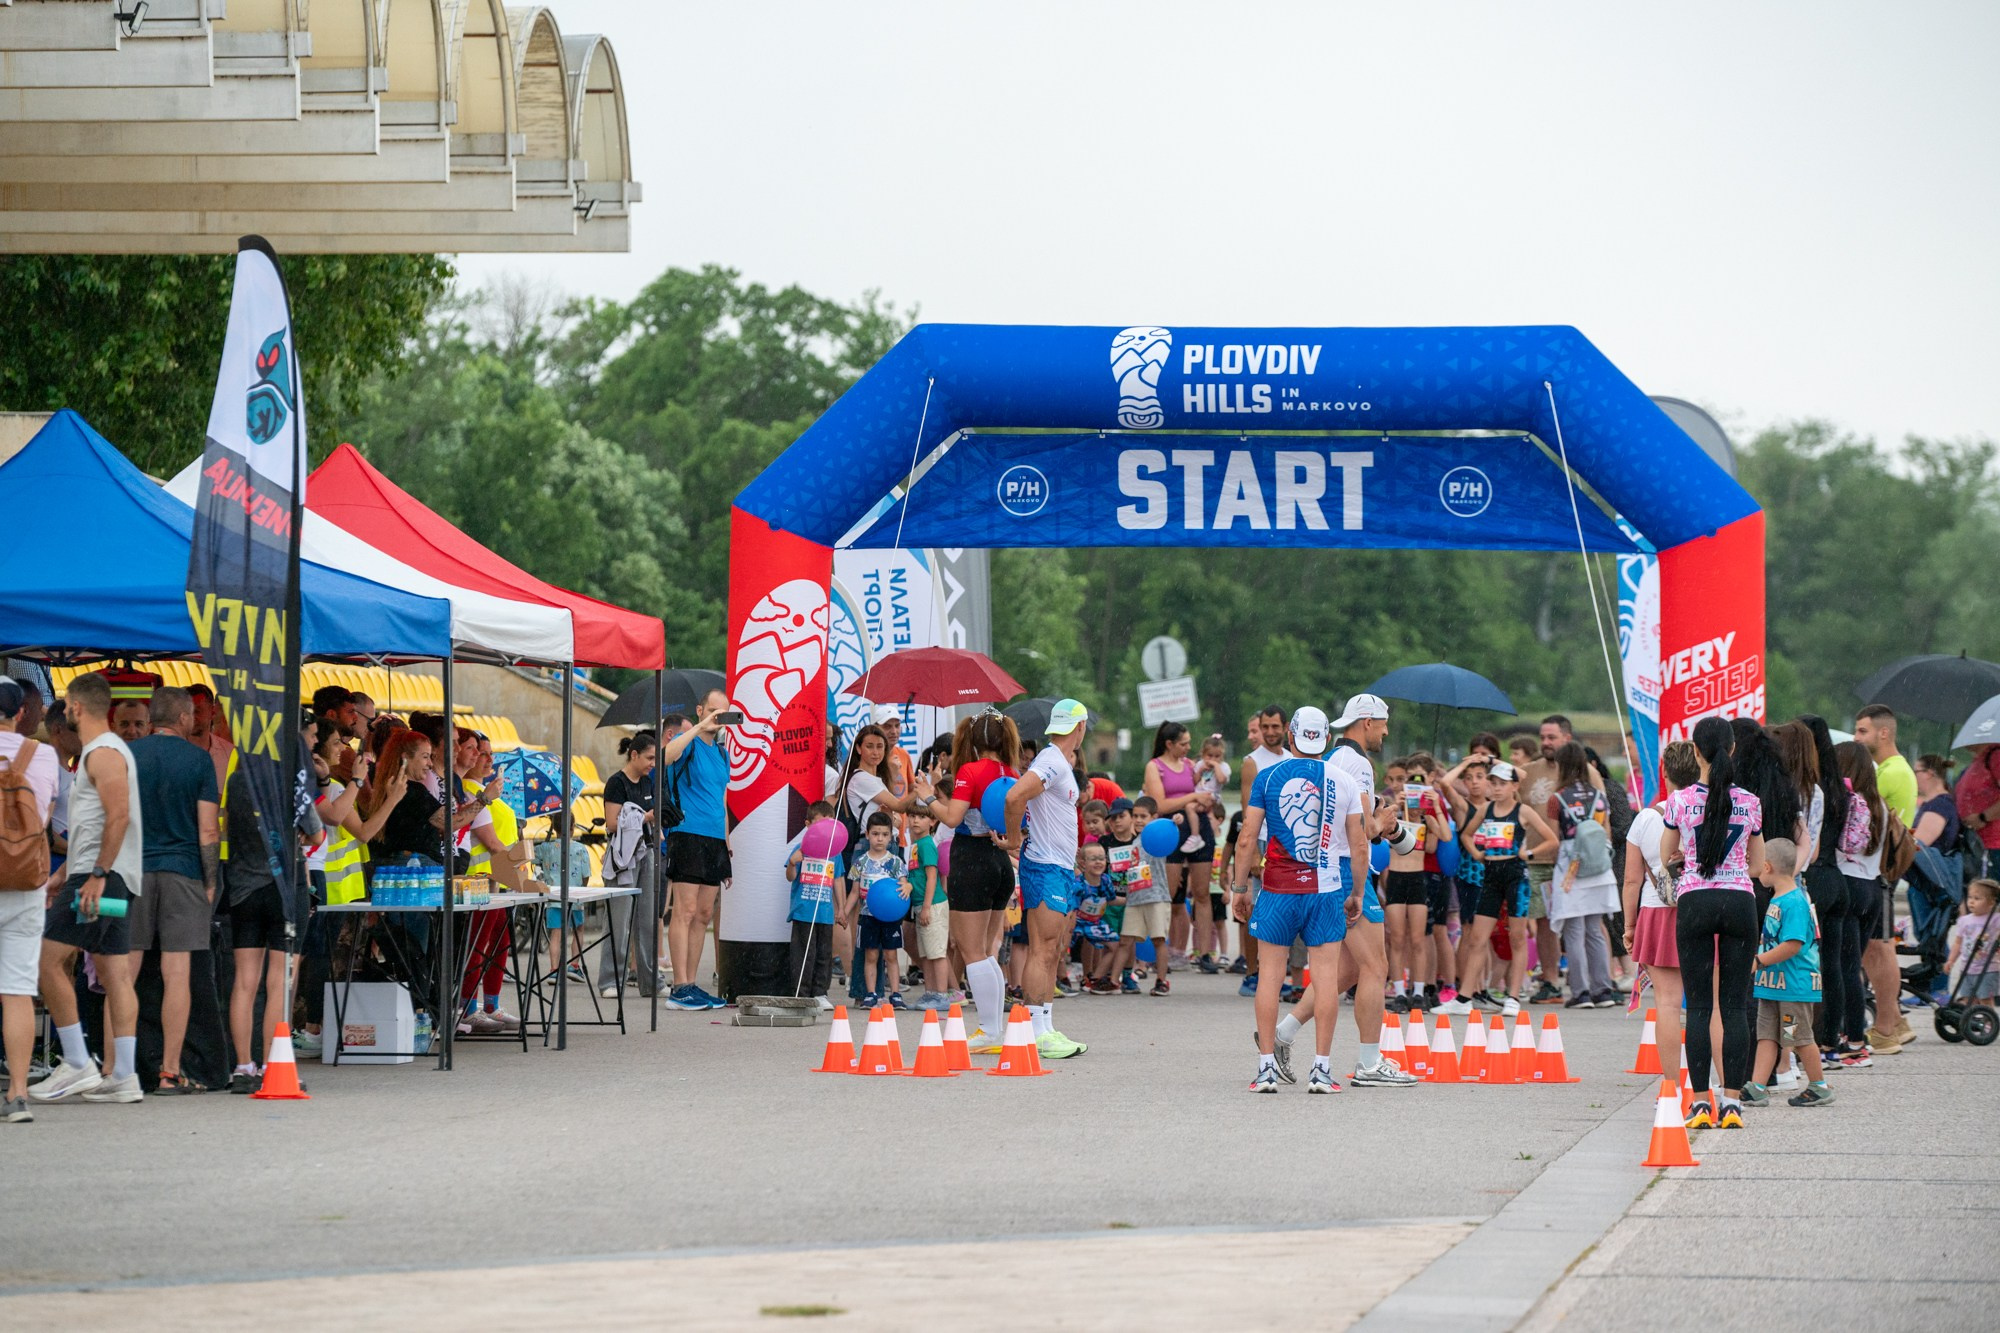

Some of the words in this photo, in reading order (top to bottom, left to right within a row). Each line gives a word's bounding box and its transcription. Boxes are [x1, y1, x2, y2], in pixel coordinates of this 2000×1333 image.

[1183, 344, 1322, 375] PLOVDIV
[1183, 383, 1272, 413] HILLS
[1281, 388, 1299, 398] IN
[1282, 402, 1372, 411] MARKOVO
[1006, 481, 1040, 498] P/H
[1116, 449, 1374, 531] START
[1448, 482, 1483, 499] P/H
[1684, 655, 1759, 715] STEP
[773, 726, 813, 743] PLOVDIV
[782, 740, 810, 755] HILLS
[1324, 777, 1336, 825] MATTERS
[1321, 823, 1332, 849] STEP
[1114, 851, 1130, 860] 105
[806, 863, 824, 873] 118
